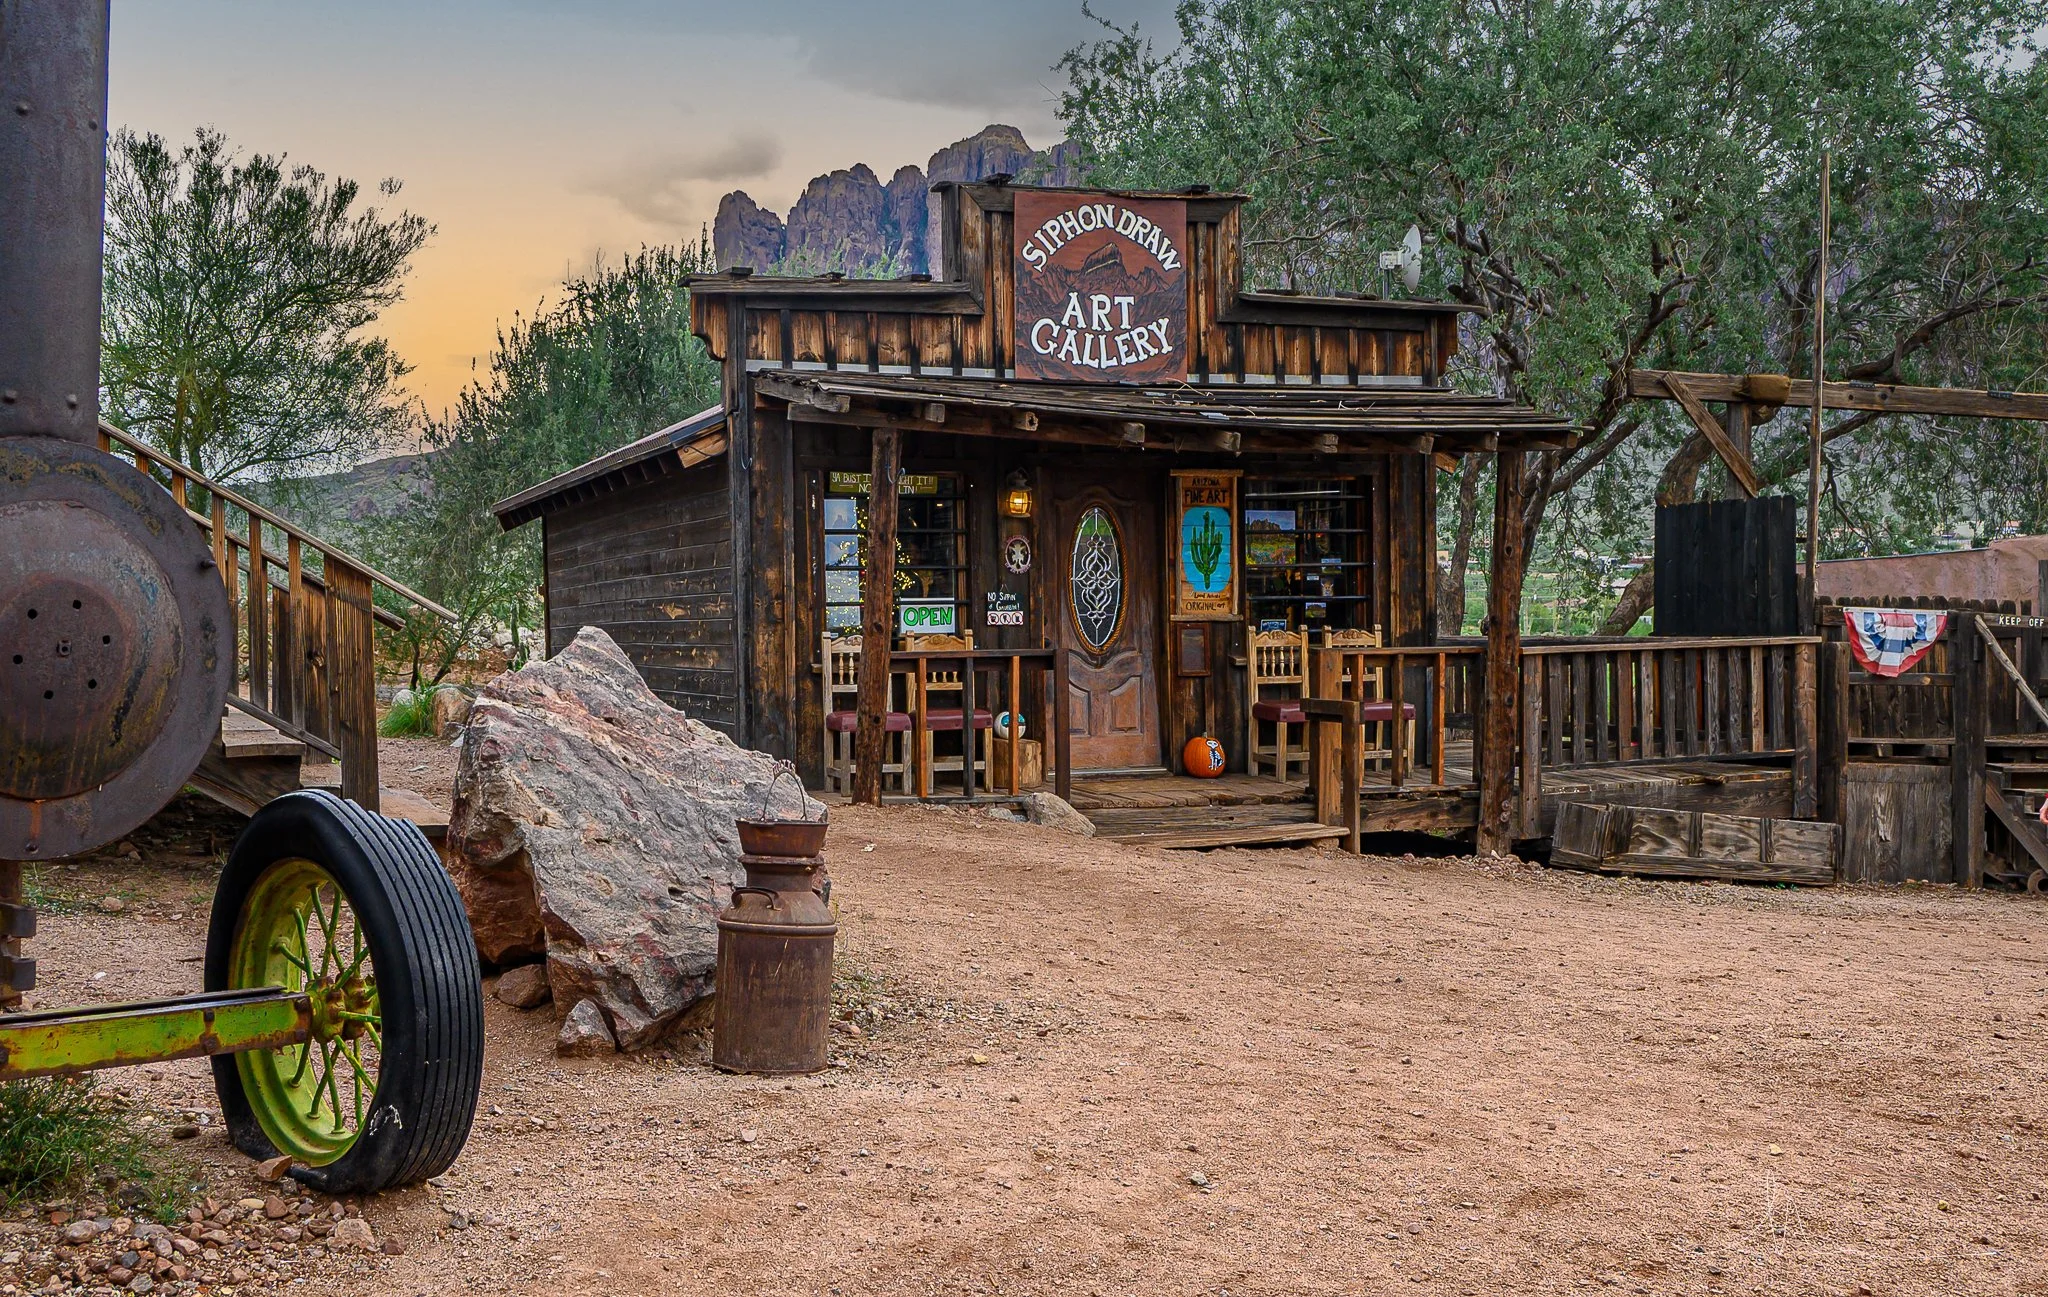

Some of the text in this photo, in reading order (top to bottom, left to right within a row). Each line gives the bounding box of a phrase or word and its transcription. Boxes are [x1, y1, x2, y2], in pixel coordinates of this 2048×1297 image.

[1021, 204, 1182, 273] SIPHON DRAW
[1061, 291, 1135, 332] ART
[1030, 317, 1173, 369] GALLERY
[843, 472, 862, 484] BUST
[1185, 489, 1227, 504] FINE ART
[987, 592, 997, 602] NO
[903, 606, 953, 626] OPEN
[1999, 615, 2045, 627] KEEP OFF
